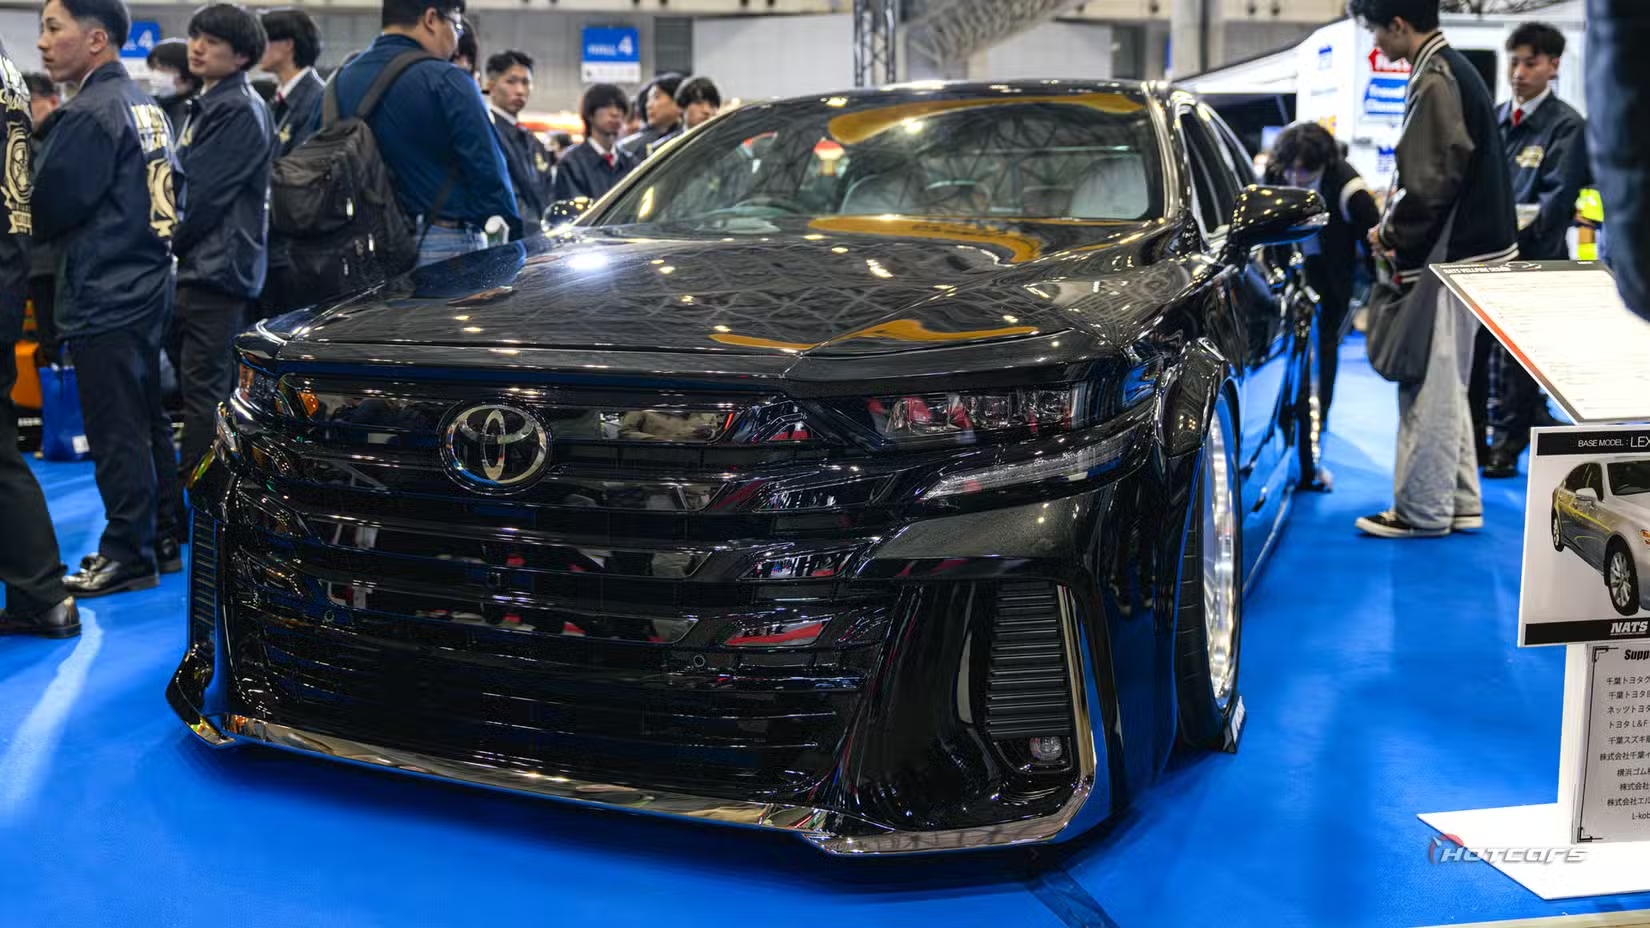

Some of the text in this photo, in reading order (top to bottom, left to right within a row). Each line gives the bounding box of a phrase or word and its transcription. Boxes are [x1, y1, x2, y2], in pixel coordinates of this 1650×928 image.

[617, 35, 633, 56] 4
[1577, 439, 1598, 448] BASE
[1598, 438, 1624, 447] MODEL
[1610, 621, 1649, 633] NATS
[1624, 649, 1650, 661] Supp
